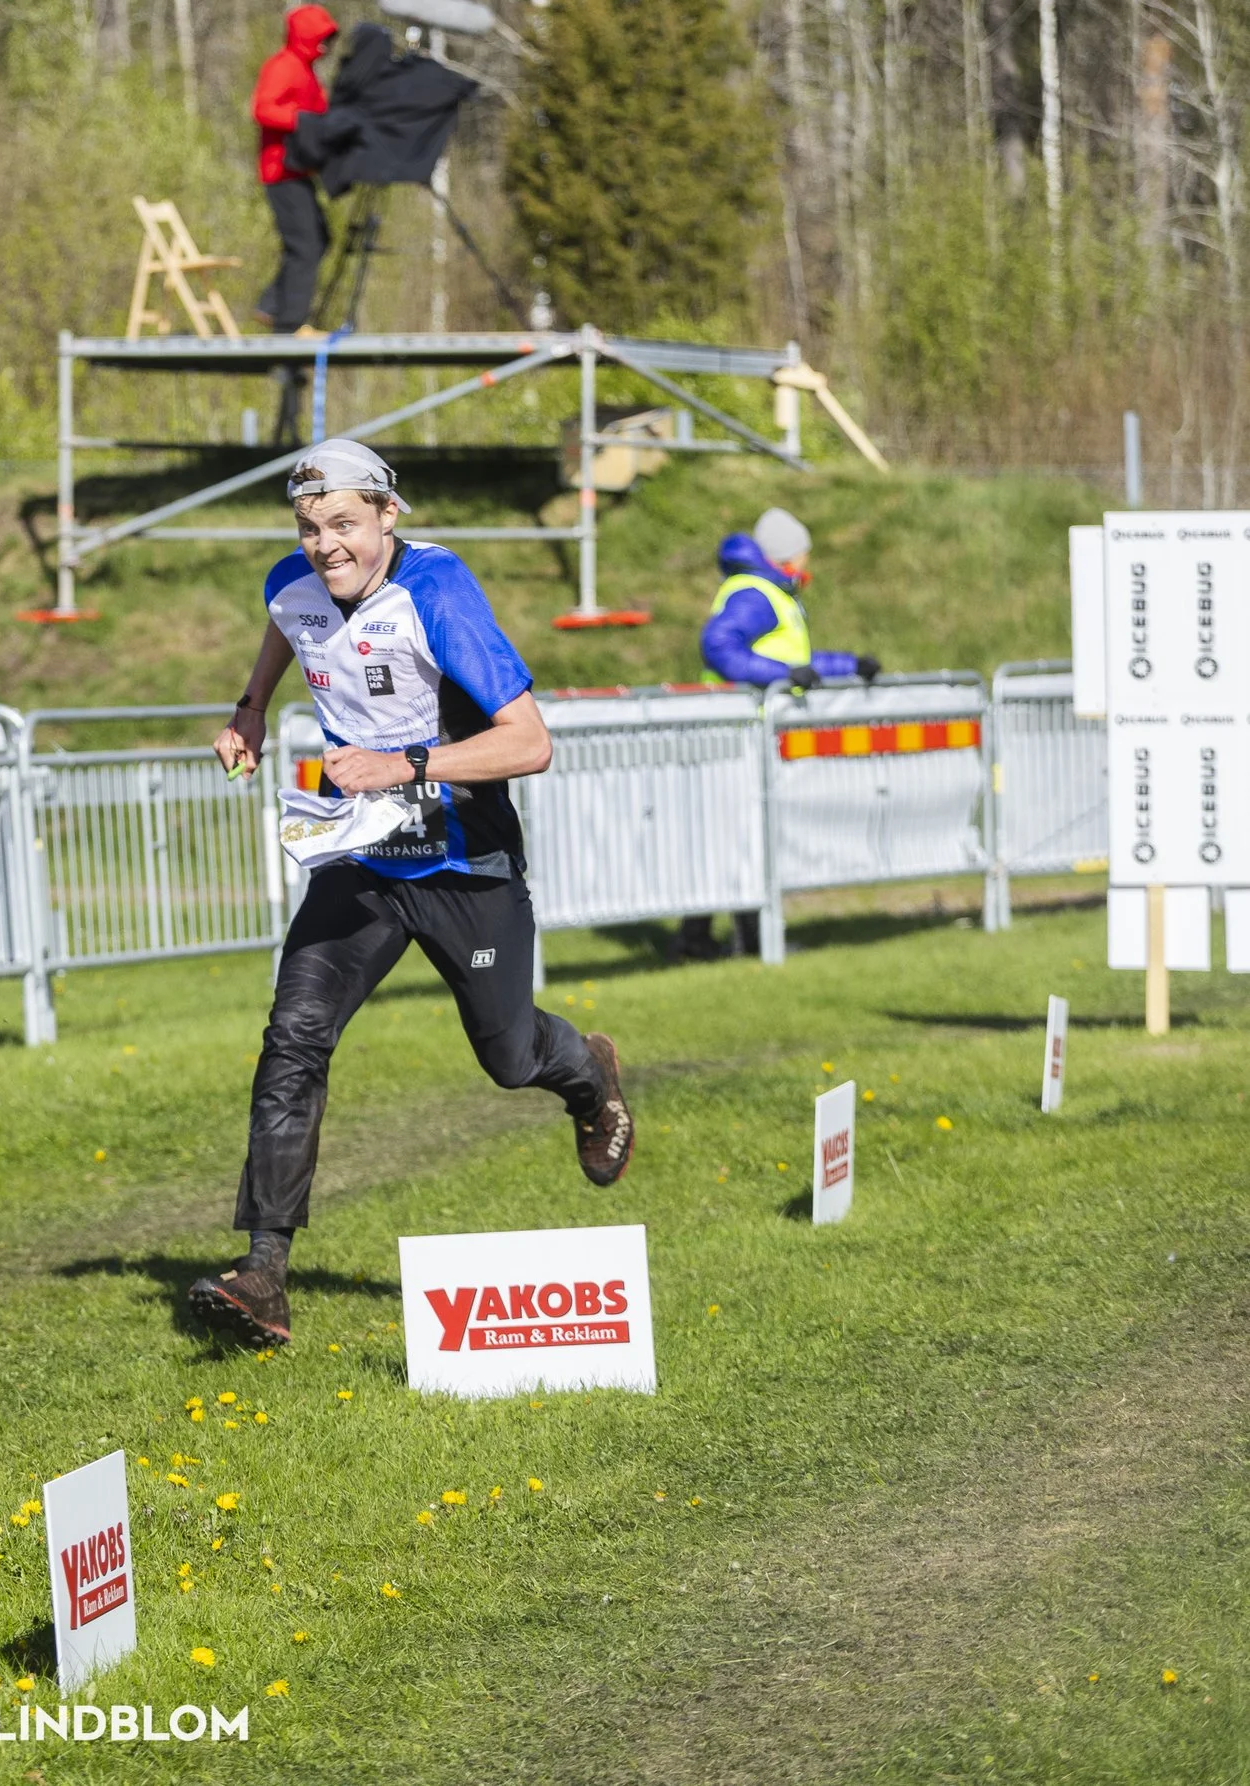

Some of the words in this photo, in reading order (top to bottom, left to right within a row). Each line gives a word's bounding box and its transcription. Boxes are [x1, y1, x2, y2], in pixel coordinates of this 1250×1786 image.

[299, 614, 328, 628] SSAB
[361, 622, 397, 633] ABECE
[1131, 562, 1146, 653] ICEBUG
[1197, 562, 1213, 653] ICEBUG
[1134, 748, 1150, 837] ICEBUG
[1201, 748, 1216, 837] ICEBUG
[423, 1279, 629, 1352] YAKOBS
[483, 1329, 525, 1345] Ram
[529, 1328, 546, 1344] &
[550, 1326, 618, 1343] Reklam
[60, 1521, 126, 1631] YAKOBS
[82, 1598, 98, 1618] Ram
